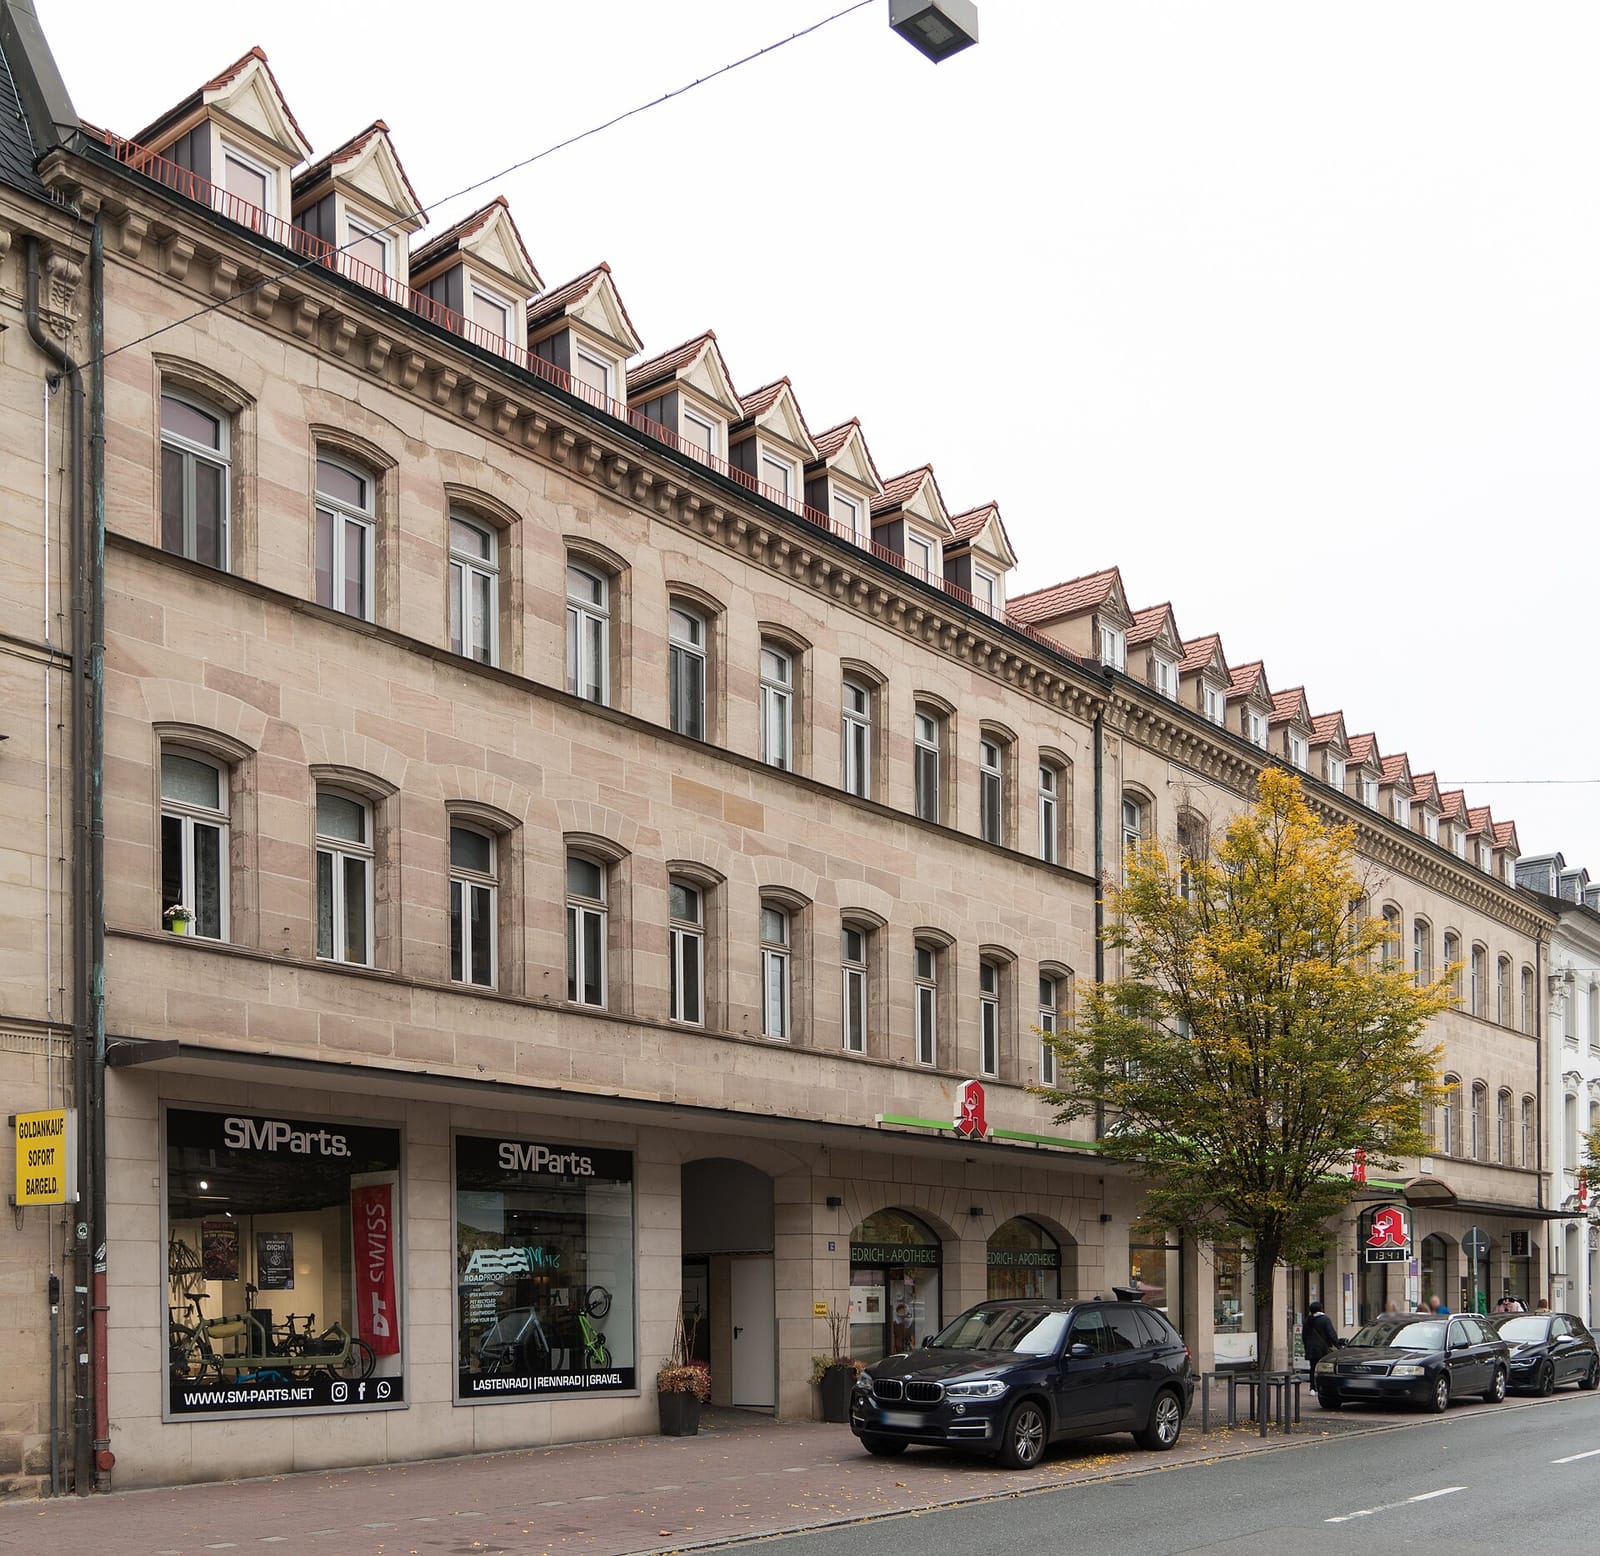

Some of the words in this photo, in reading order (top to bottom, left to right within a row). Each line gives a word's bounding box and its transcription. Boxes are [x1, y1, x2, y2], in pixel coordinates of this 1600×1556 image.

[19, 1118, 64, 1139] GOLDANKAUF
[224, 1117, 352, 1157] SMParts.
[28, 1148, 55, 1166] SOFORT
[498, 1142, 595, 1176] SMParts.
[26, 1177, 57, 1195] BARGELD
[366, 1203, 387, 1284] SWISS
[891, 1249, 936, 1263] APOTHEKE
[372, 1291, 390, 1337] DT
[184, 1387, 314, 1405] WWW.SM-PARTS.NET
